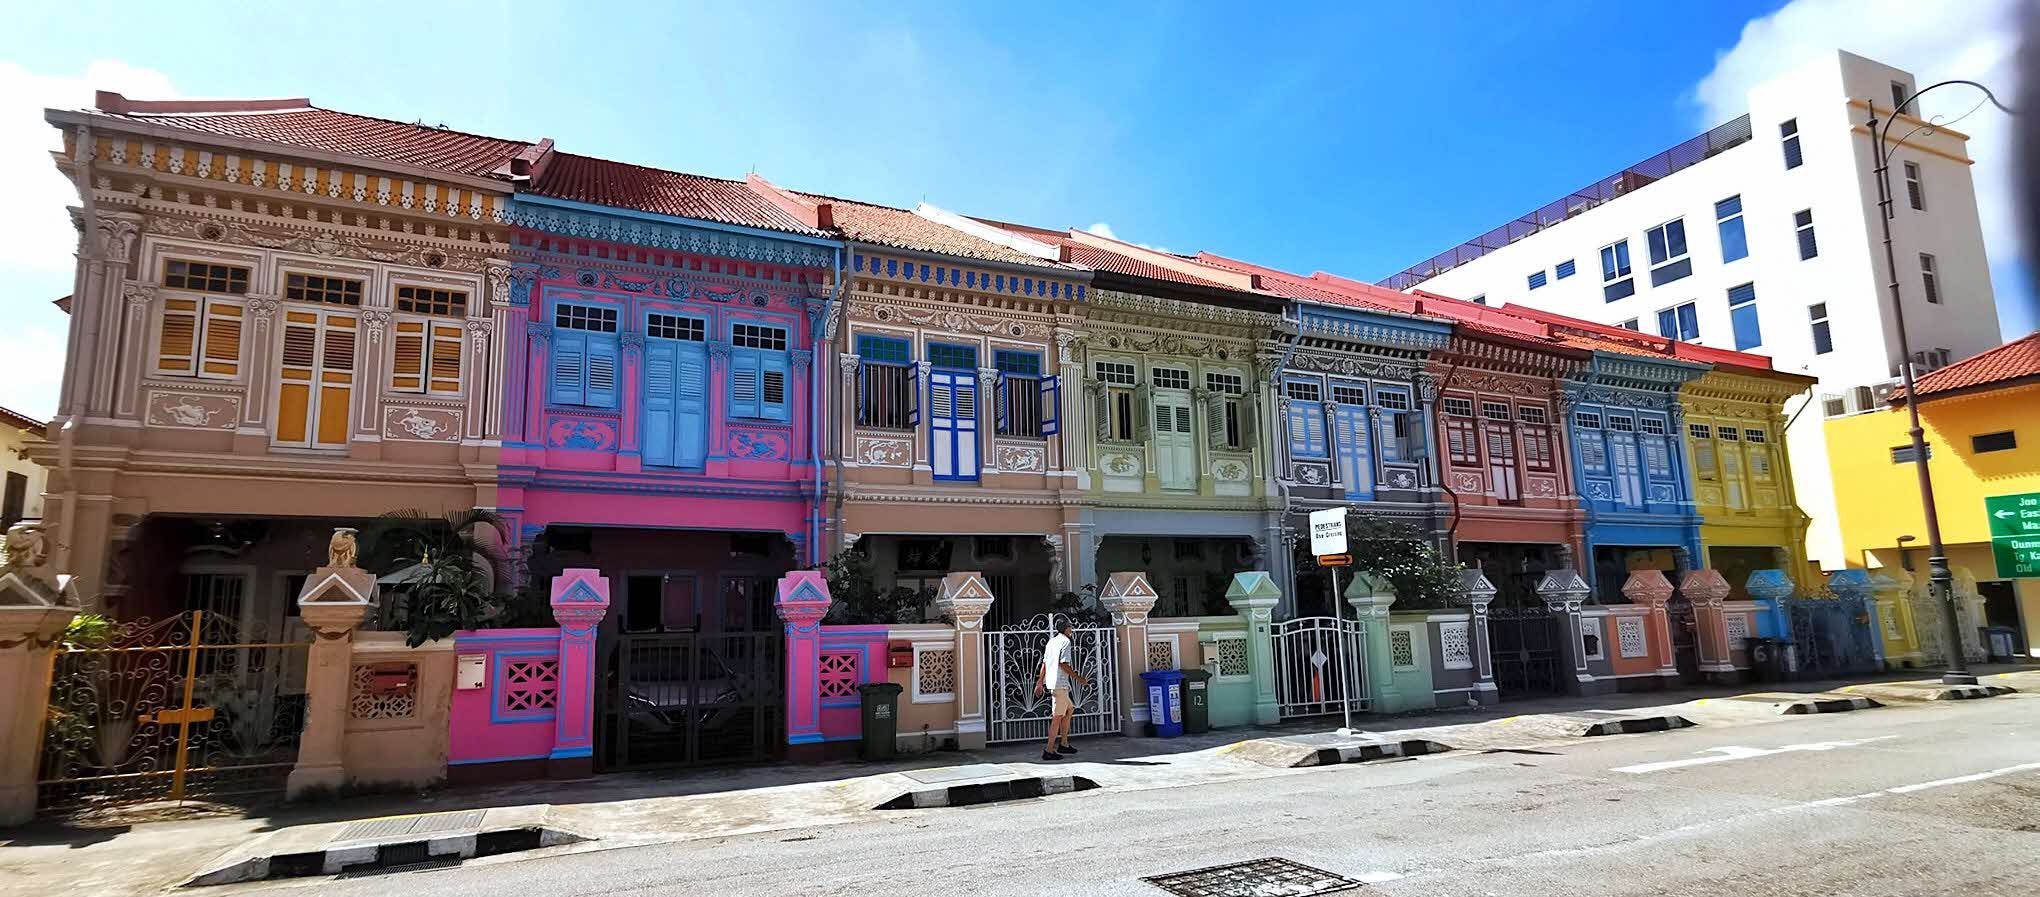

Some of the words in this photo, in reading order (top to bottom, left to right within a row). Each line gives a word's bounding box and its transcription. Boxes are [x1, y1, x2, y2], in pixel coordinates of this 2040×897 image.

[2022, 521, 2040, 530] Ma
[2016, 564, 2032, 572] Old
[1754, 646, 1767, 662] 6
[1194, 695, 1204, 706] 12
